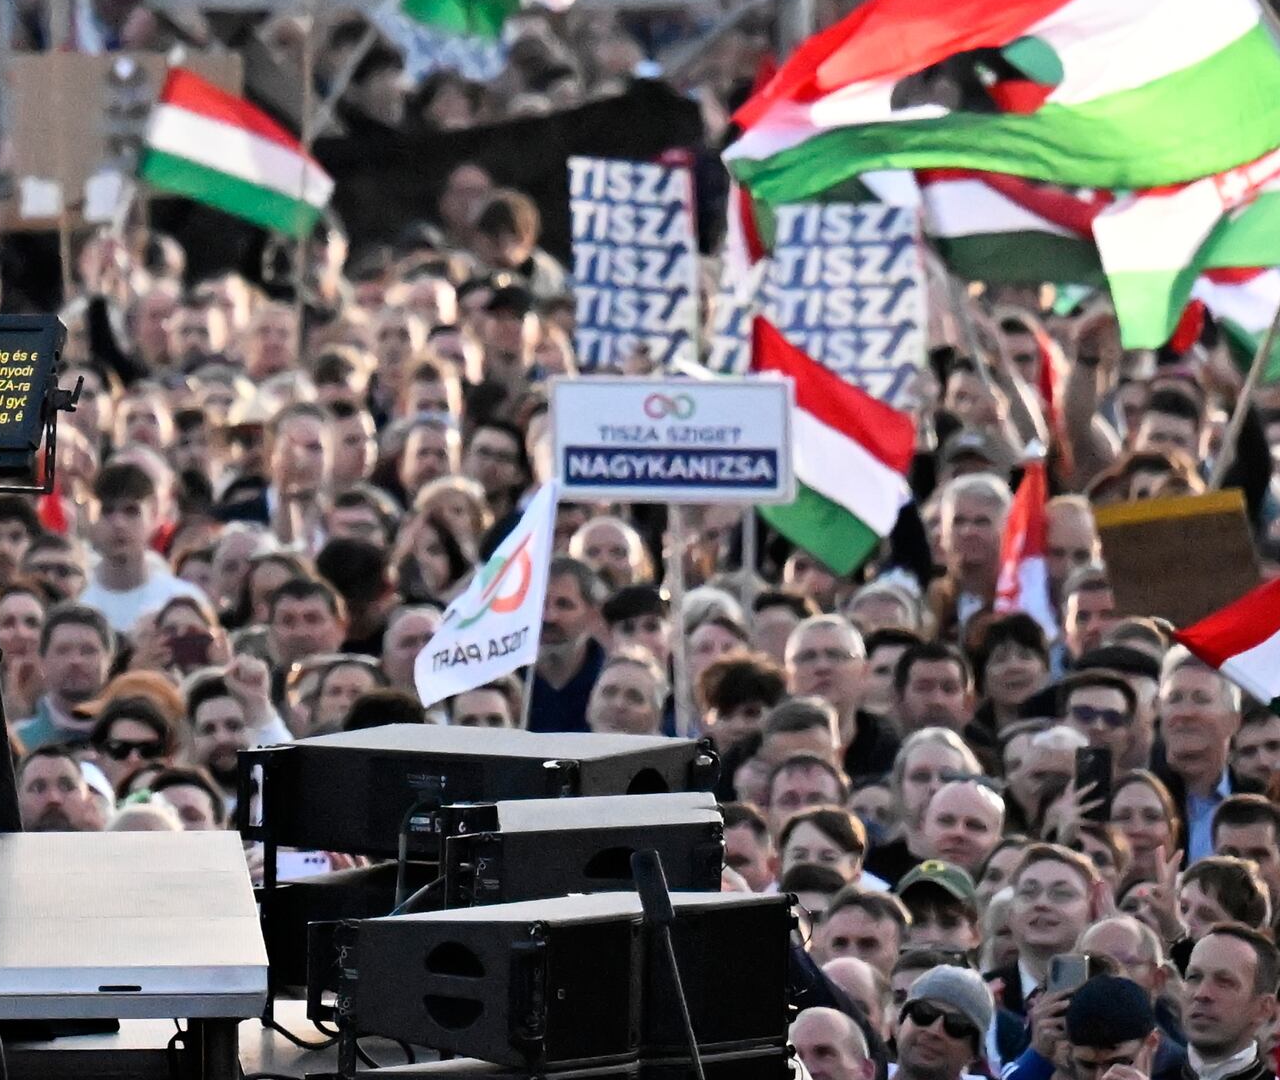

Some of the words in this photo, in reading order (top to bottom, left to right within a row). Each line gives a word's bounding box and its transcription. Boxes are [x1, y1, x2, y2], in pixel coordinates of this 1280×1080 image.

[567, 157, 692, 202] TISZA
[570, 202, 693, 244] TISZA
[777, 205, 919, 245] TISZA
[573, 244, 694, 288] TISZA
[776, 245, 919, 286] TISZA
[574, 287, 696, 330] TISZA
[13, 350, 27, 361] és
[598, 425, 660, 443] TISZA
[666, 425, 742, 444] SZIGET
[568, 452, 774, 481] NAGYKANIZSA
